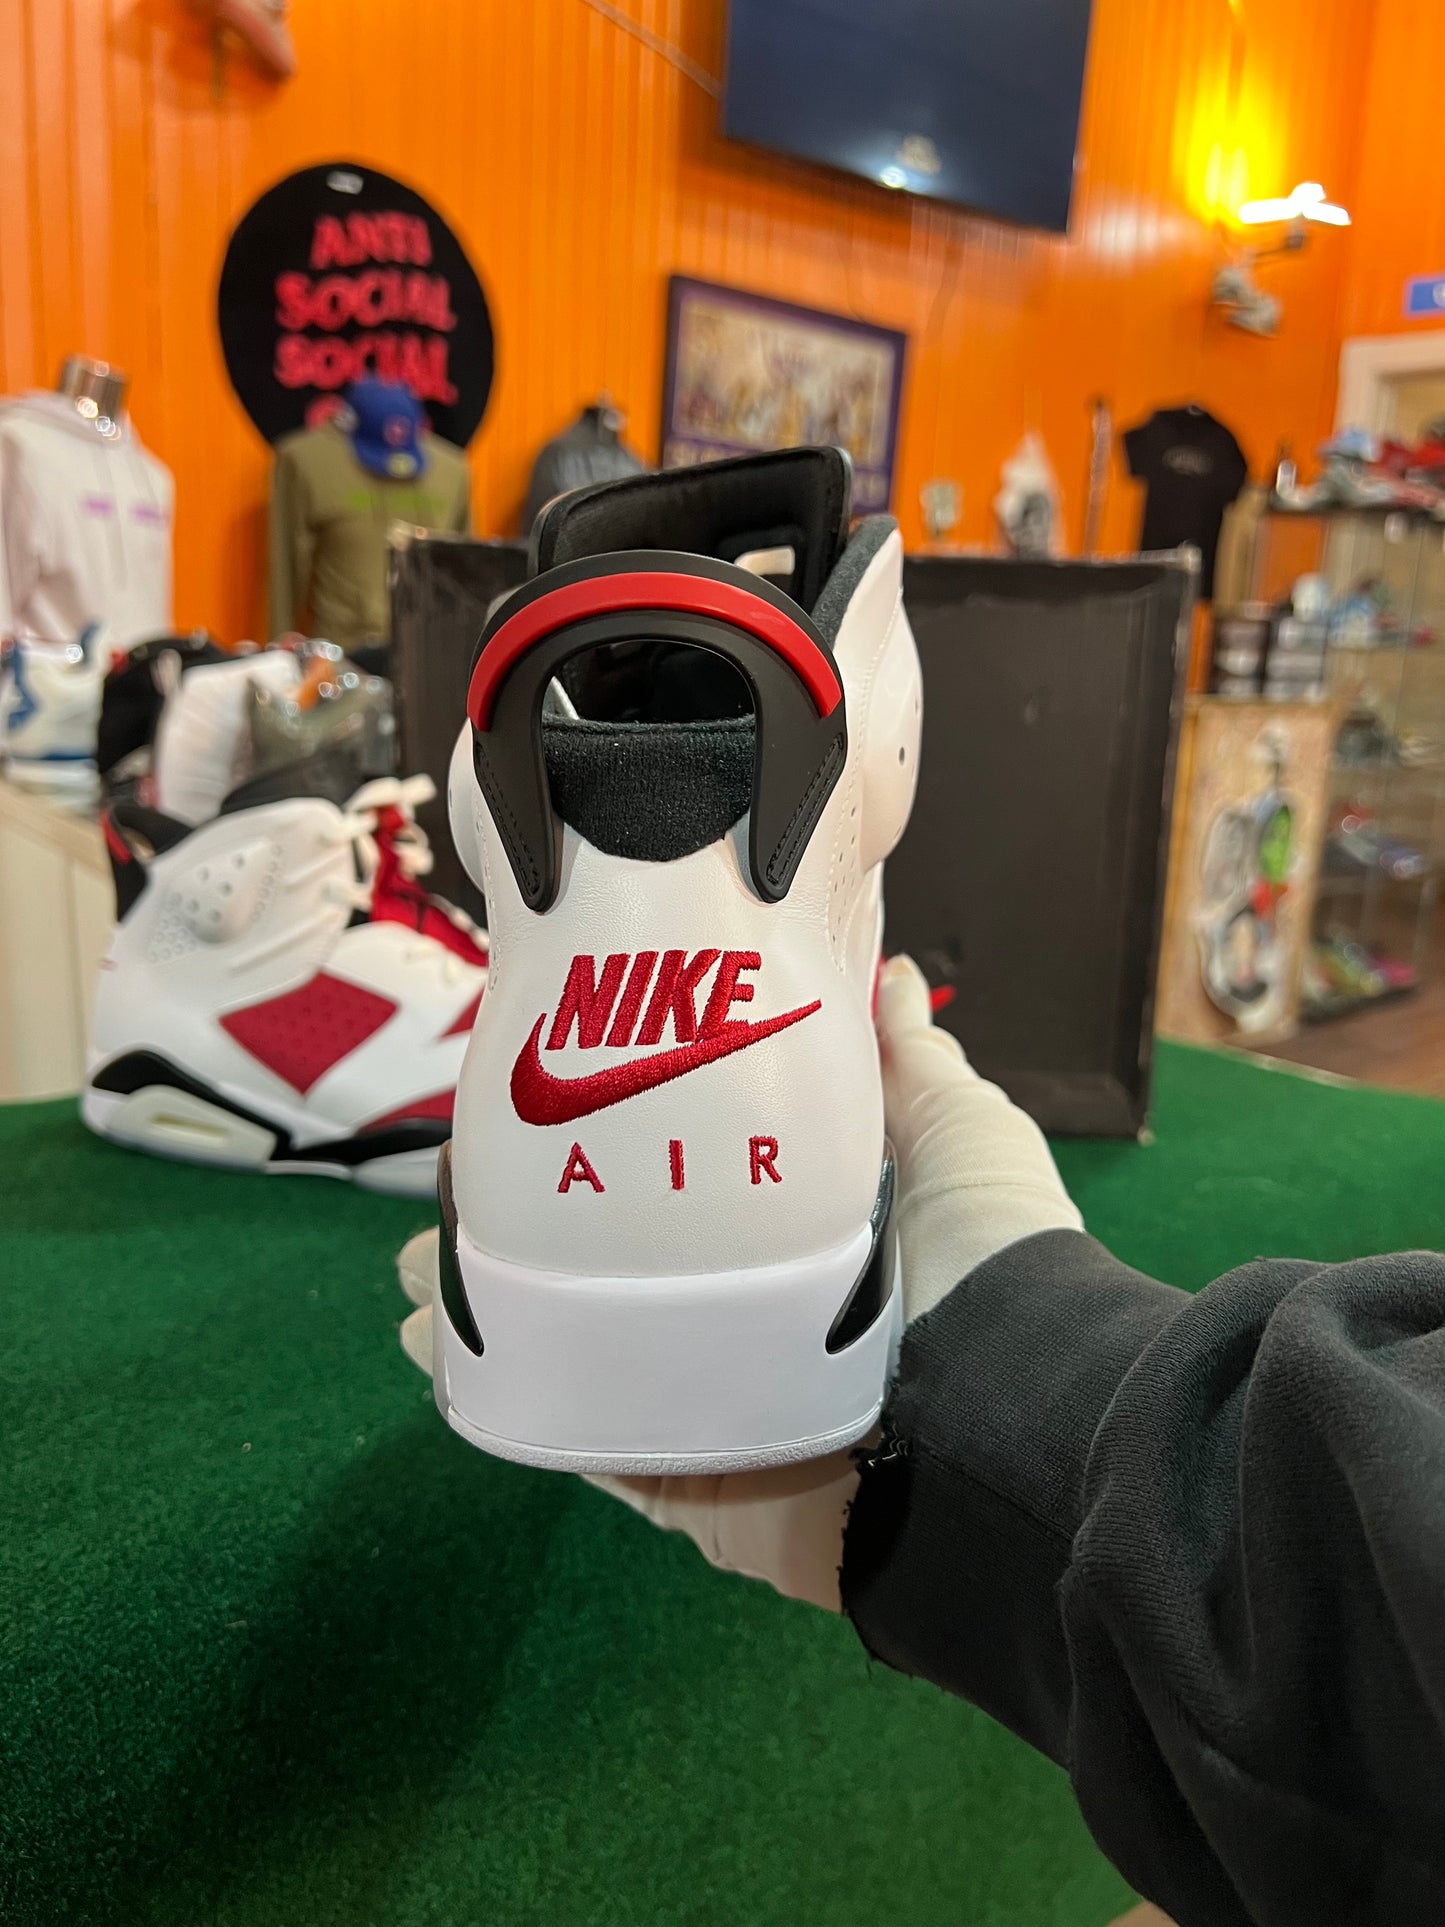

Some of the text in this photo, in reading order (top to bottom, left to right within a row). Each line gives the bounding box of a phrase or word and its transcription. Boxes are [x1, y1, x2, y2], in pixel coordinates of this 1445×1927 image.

[310, 211, 432, 269] ANTI
[275, 267, 457, 332] SOCIAL
[545, 948, 761, 1050] NIKE
[557, 1135, 783, 1193] AIR
